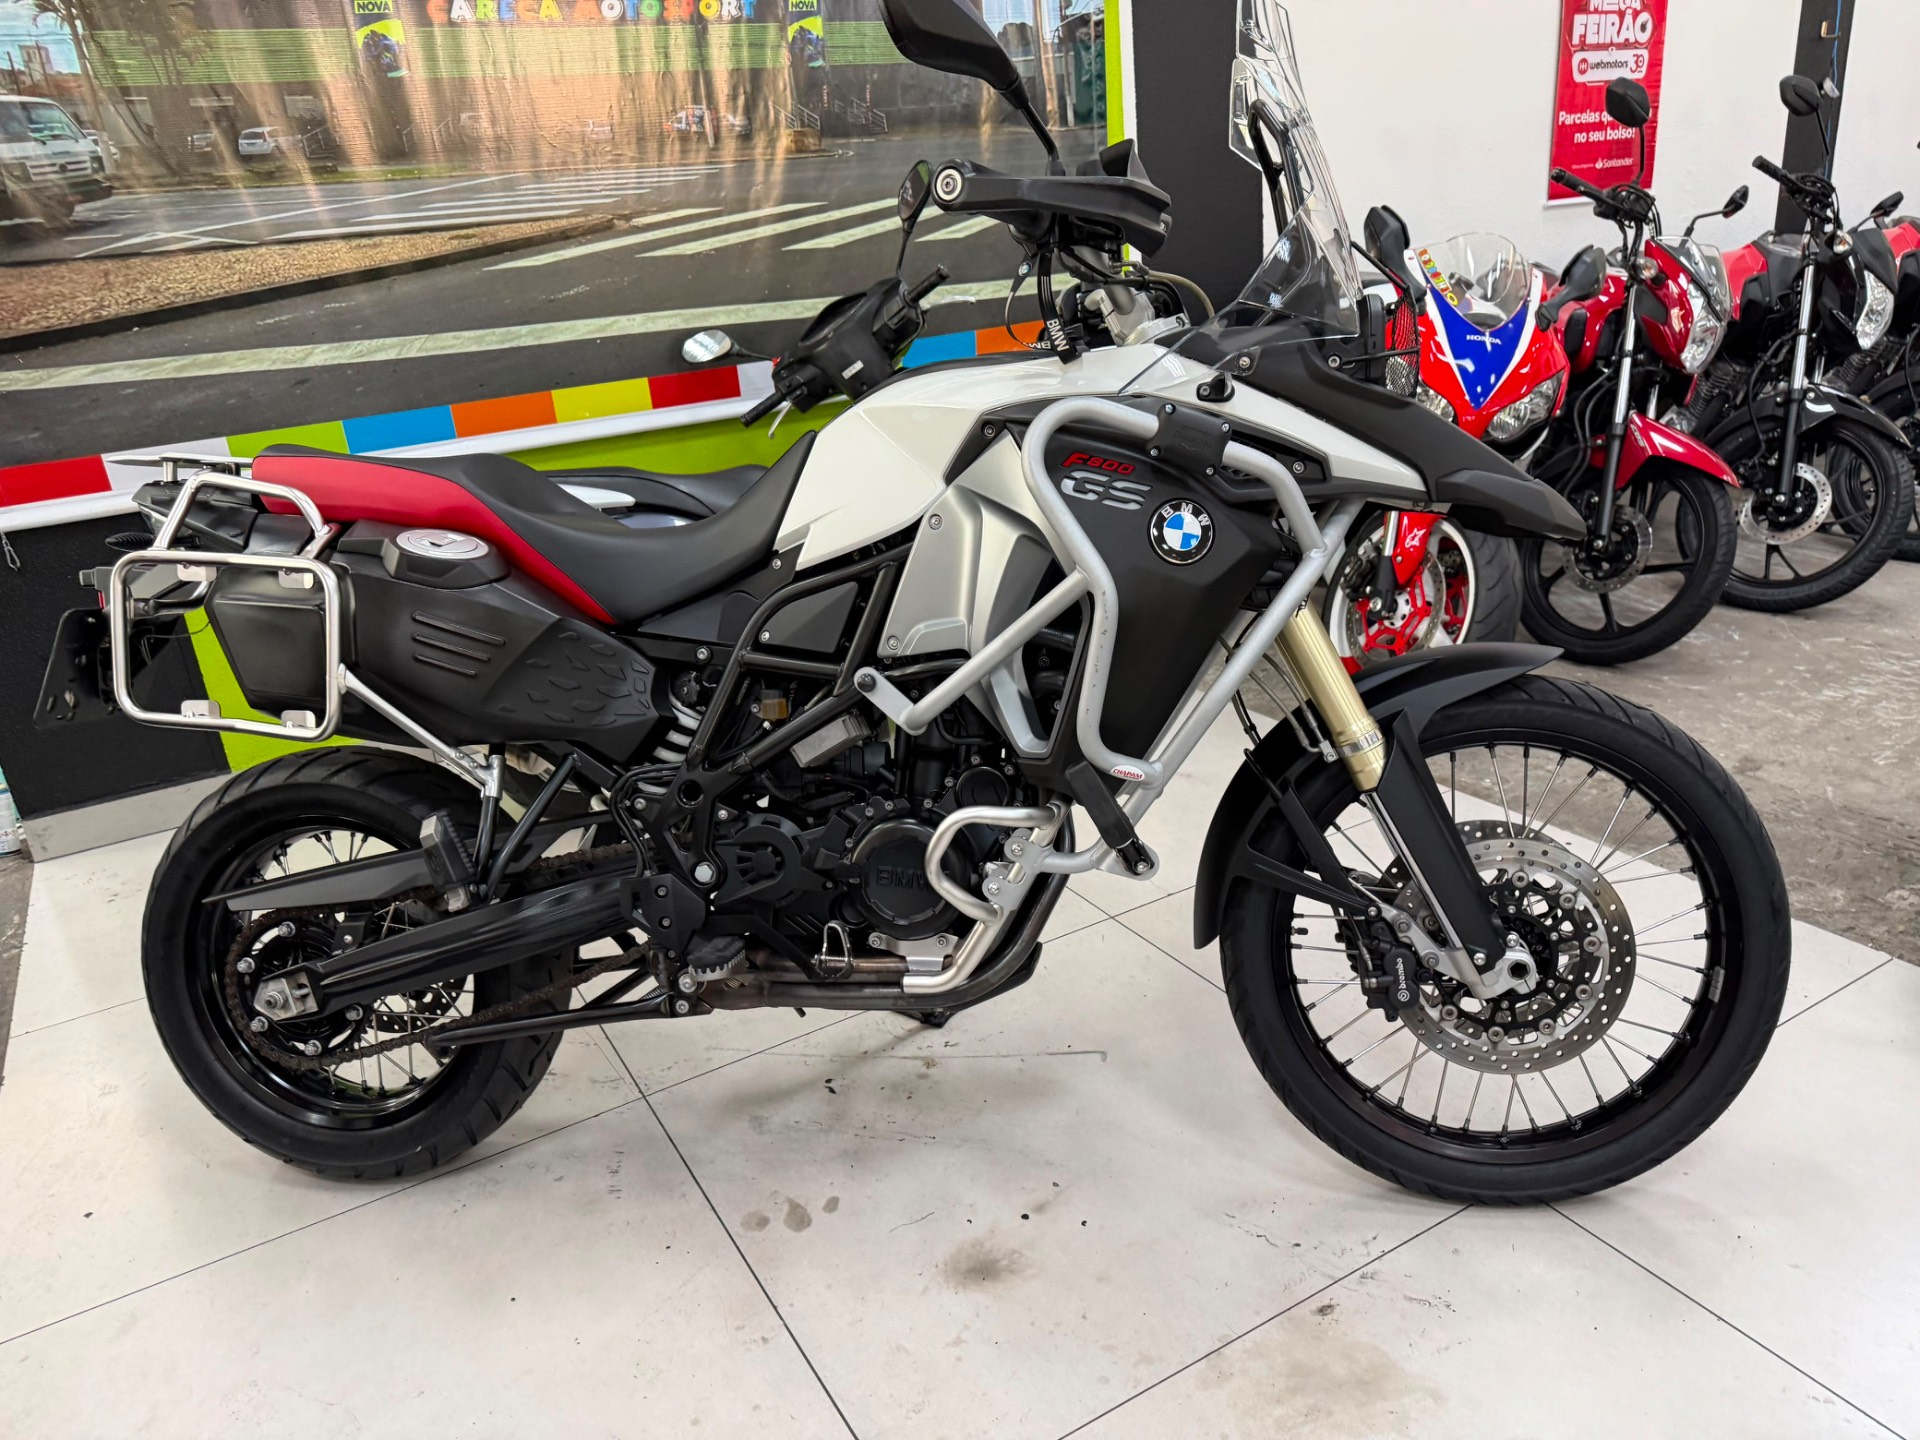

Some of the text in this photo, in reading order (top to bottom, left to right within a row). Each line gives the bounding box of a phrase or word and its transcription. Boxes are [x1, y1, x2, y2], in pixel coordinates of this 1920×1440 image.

[356, 1, 391, 13] NOVA
[426, 0, 564, 21] CARECA
[790, 0, 816, 11] NOVA
[1572, 7, 1653, 45] FEIRÃO
[1589, 59, 1629, 70] webmotors
[1558, 109, 1600, 126] Parcelas
[1573, 125, 1636, 144] no seu bolso!
[1602, 156, 1634, 169] Santander
[1046, 318, 1070, 351] BMW
[1466, 334, 1502, 345] HONDA
[1061, 451, 1136, 476] F800
[1060, 469, 1152, 510] GS
[1160, 502, 1211, 527] BMW
[1112, 768, 1143, 780] CHAPAM
[1395, 957, 1407, 989] brembo
